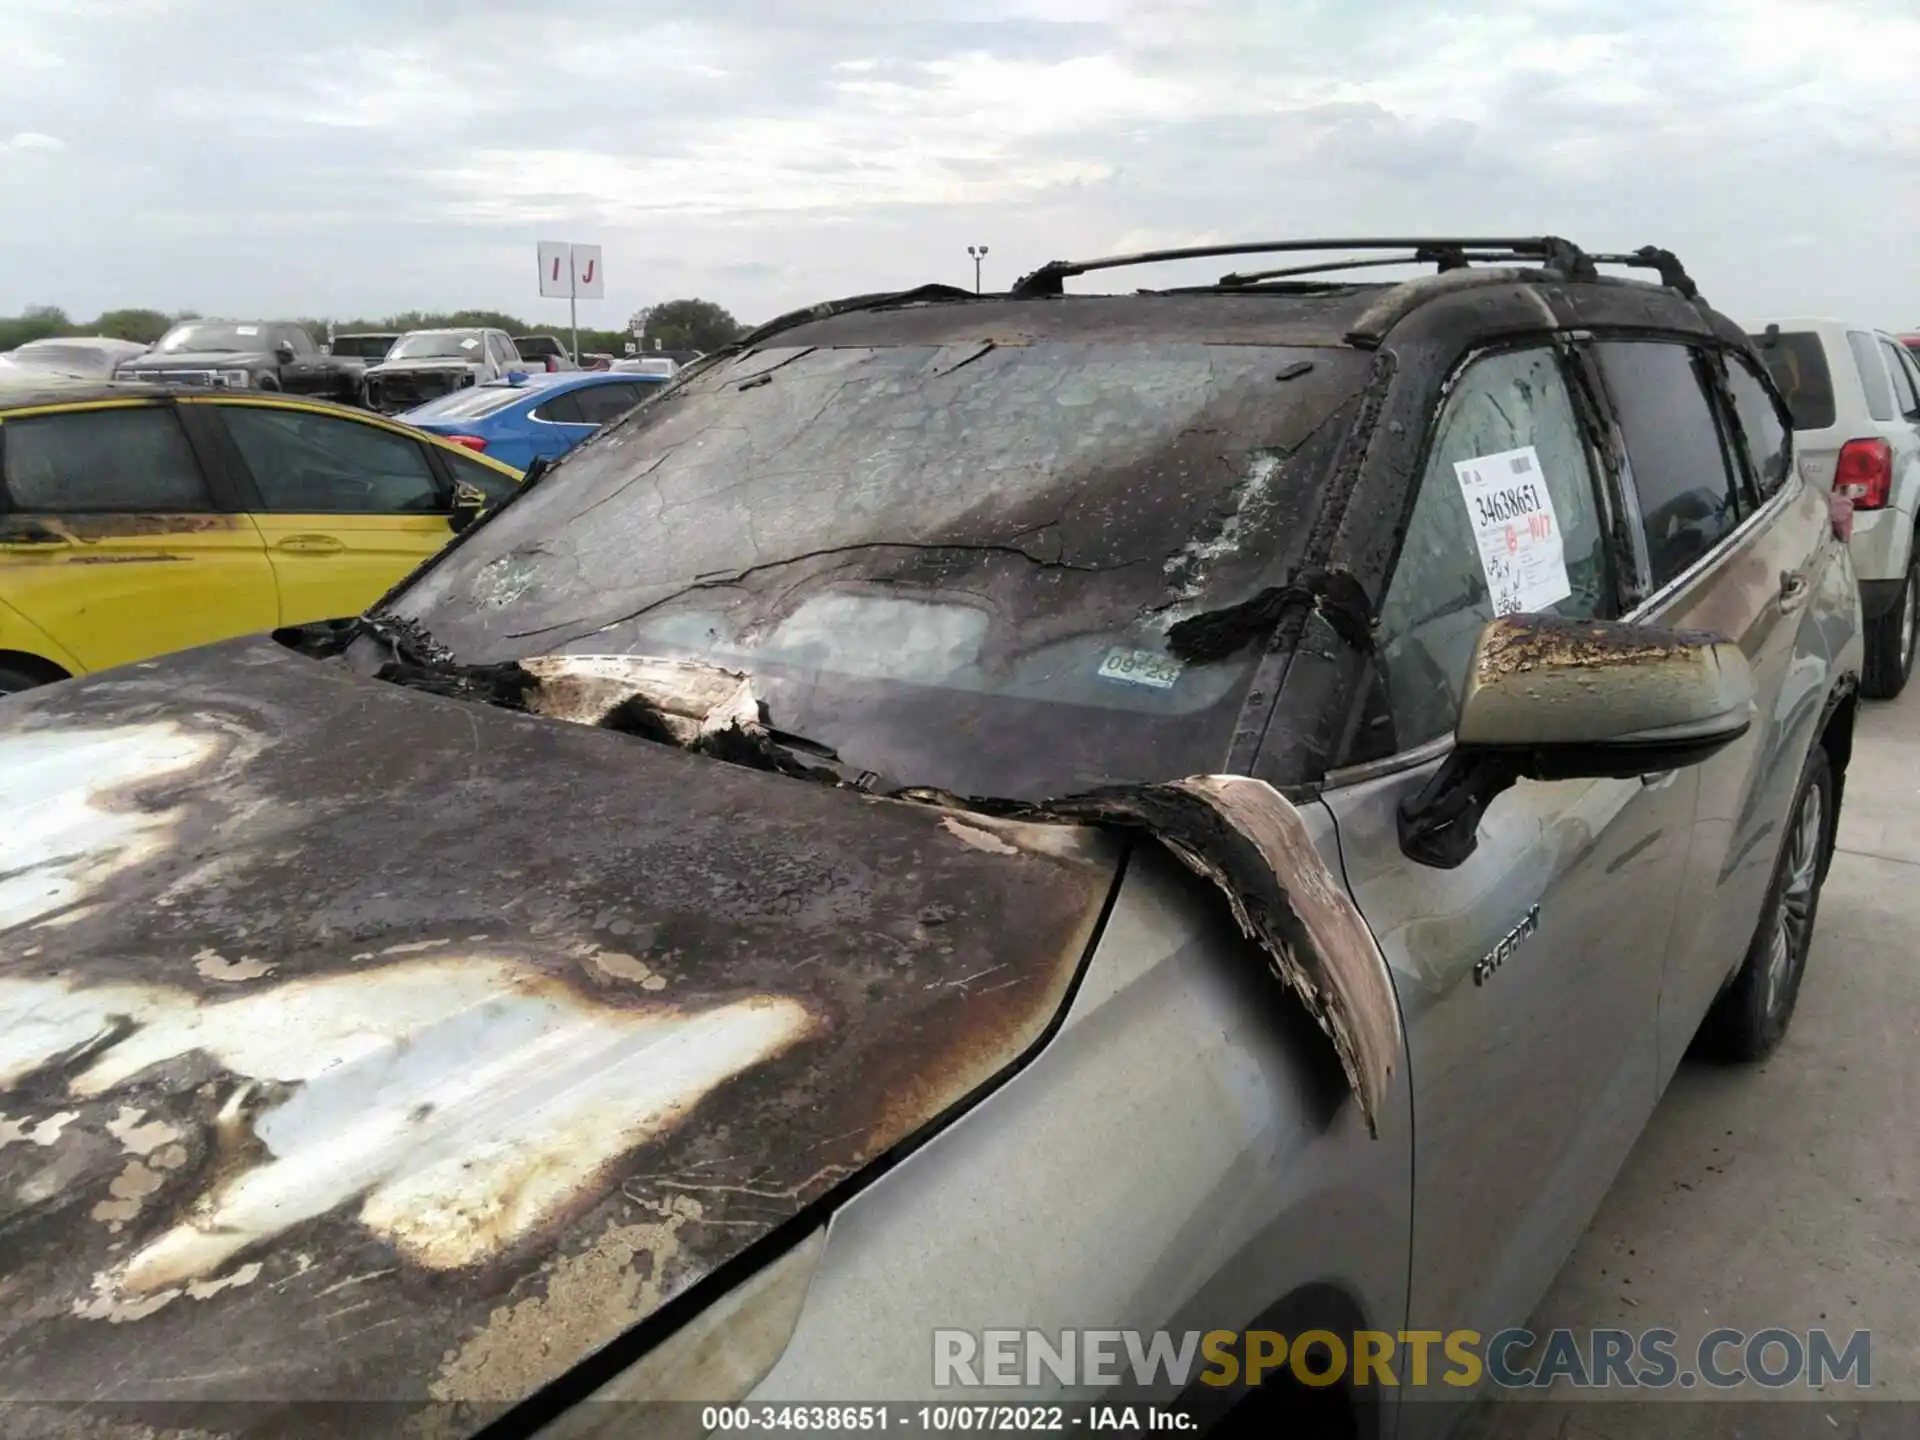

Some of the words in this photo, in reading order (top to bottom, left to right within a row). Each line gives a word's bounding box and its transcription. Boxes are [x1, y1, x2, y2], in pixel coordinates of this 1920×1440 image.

[552, 257, 560, 281] I
[582, 259, 594, 284] J
[1476, 484, 1542, 527] 34638651
